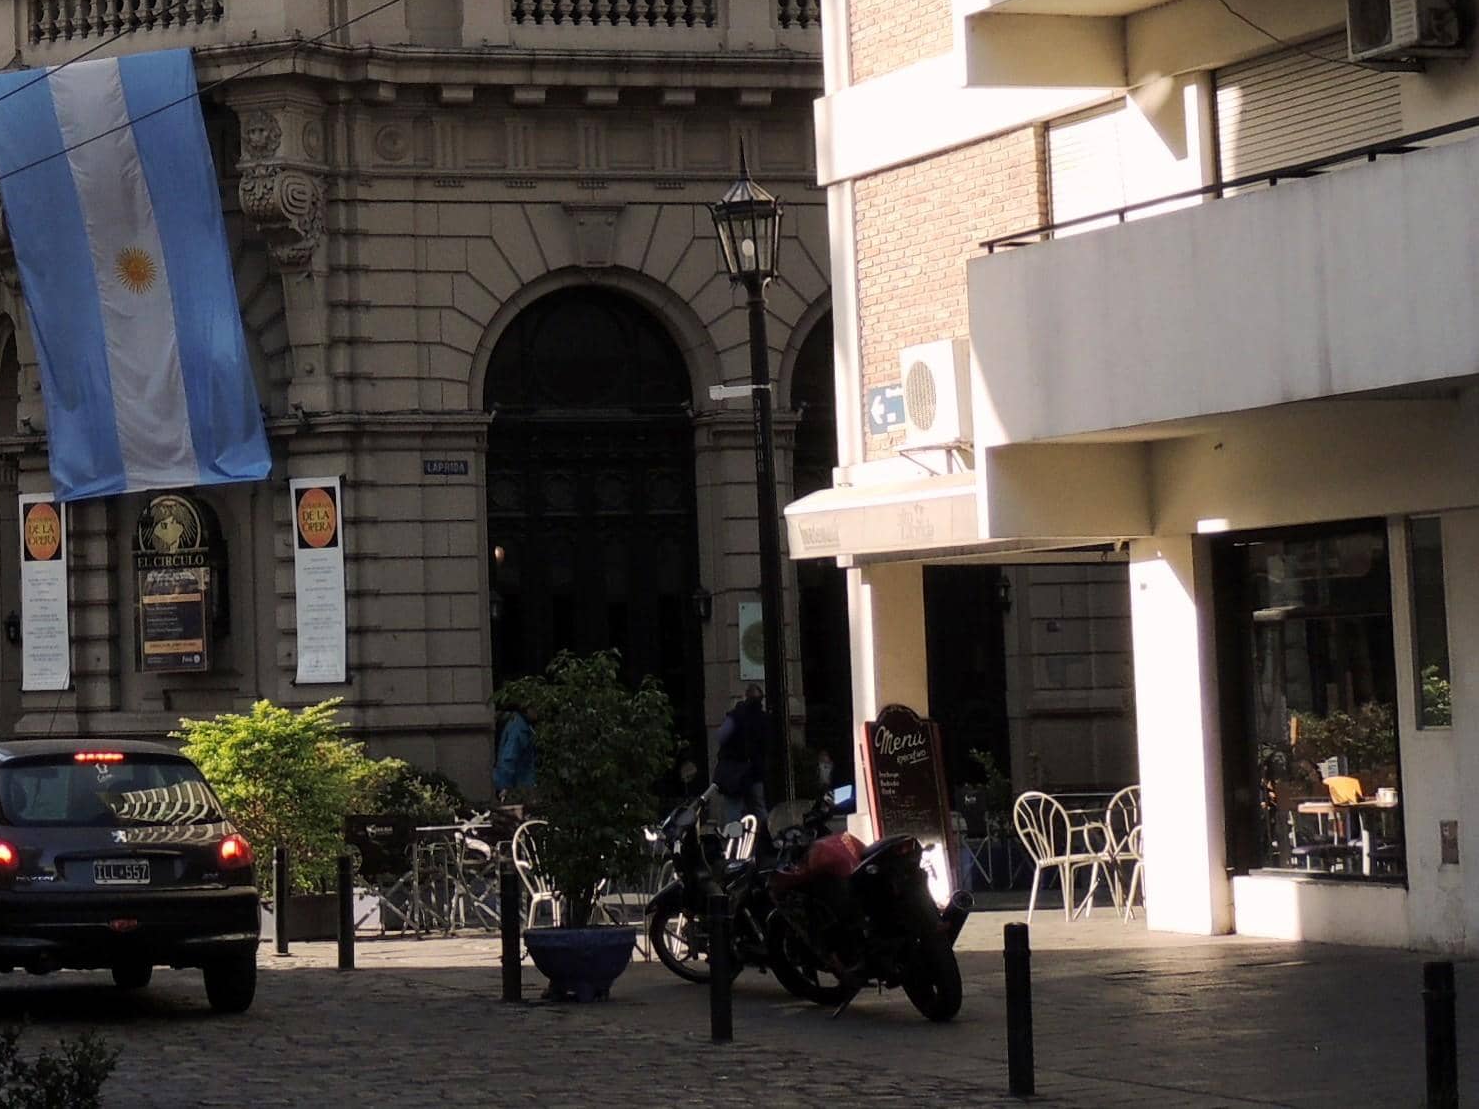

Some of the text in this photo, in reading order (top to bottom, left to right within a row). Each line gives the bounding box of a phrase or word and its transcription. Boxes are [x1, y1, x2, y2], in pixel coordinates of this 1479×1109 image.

[137, 557, 150, 568] EL
[96, 865, 147, 879] ILL 557
